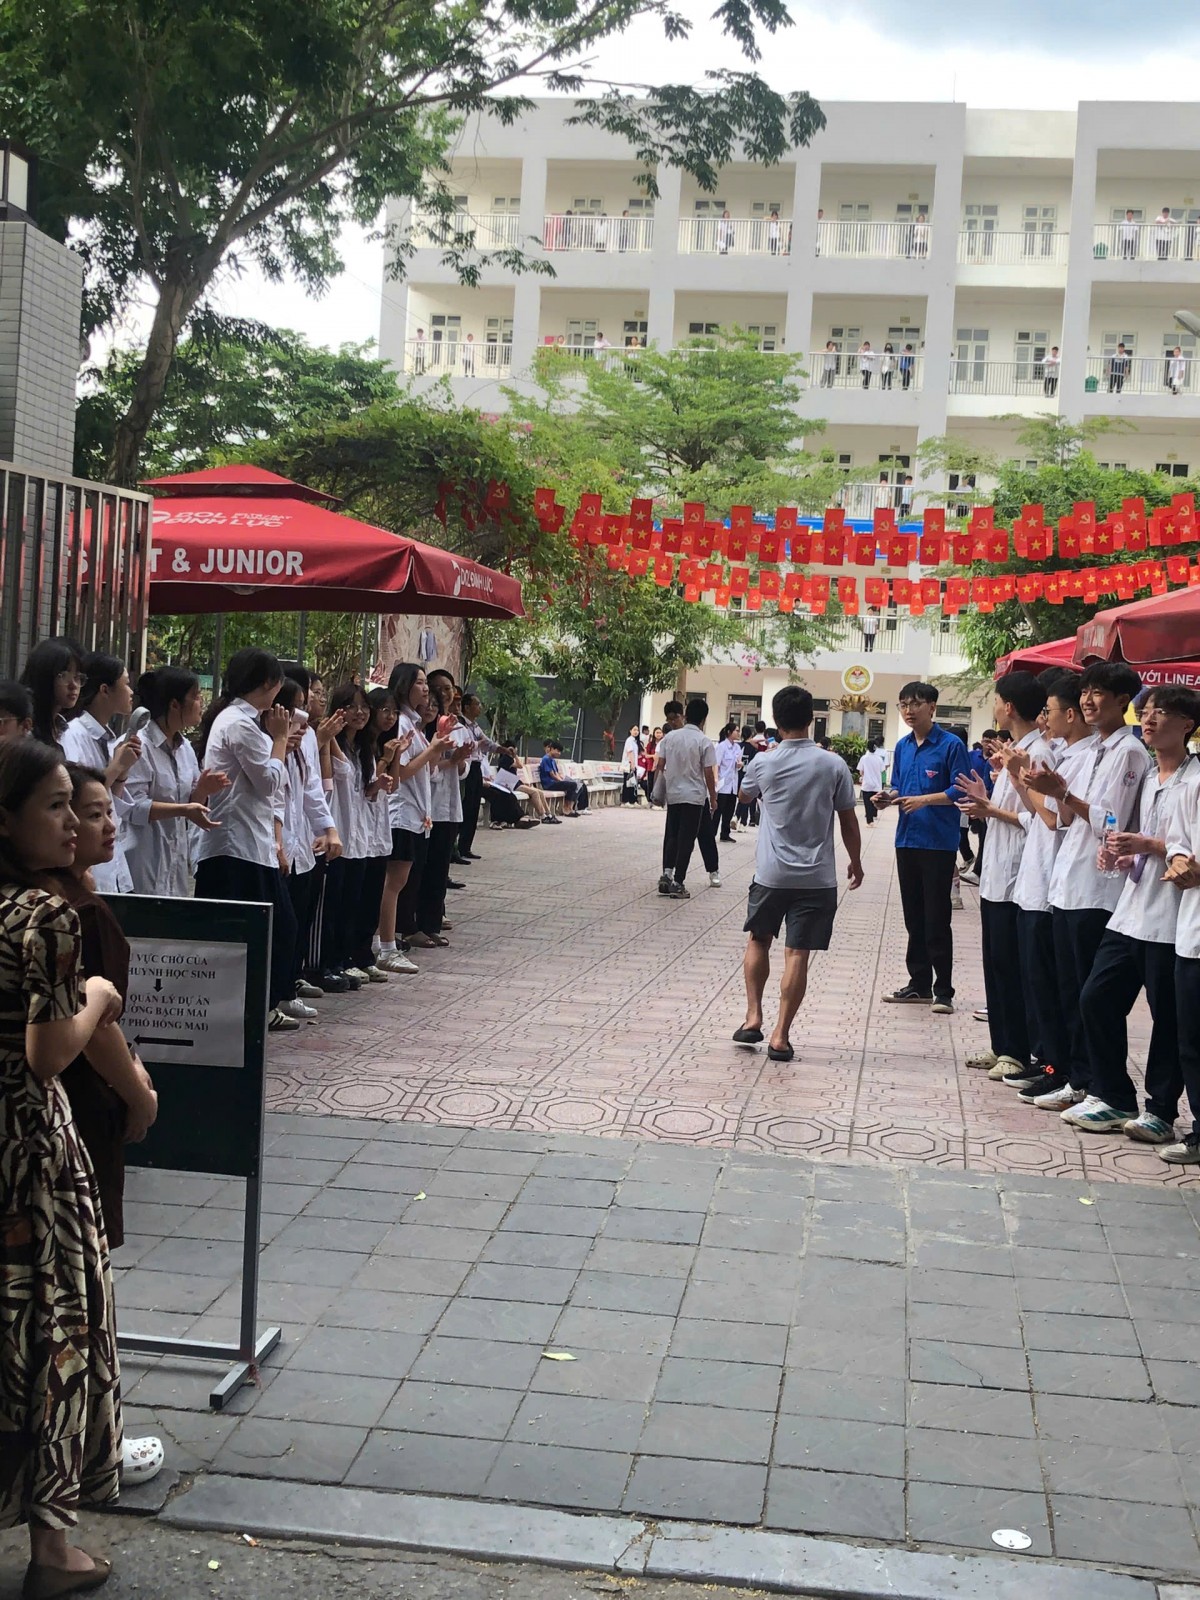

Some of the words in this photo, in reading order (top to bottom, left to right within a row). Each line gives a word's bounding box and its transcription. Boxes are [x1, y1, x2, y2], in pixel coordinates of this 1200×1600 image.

[172, 548, 191, 573] &
[199, 548, 304, 576] JUNIOR
[1138, 669, 1161, 683] VỚI
[137, 953, 159, 964] VỰC
[161, 953, 185, 964] CHỜ
[186, 954, 208, 966] CỦA
[165, 969, 189, 979] HỌC
[191, 970, 216, 979] SINH
[162, 994, 176, 1004] LÝ
[125, 1003, 153, 1014] ƯỜNG
[155, 1007, 184, 1018] BẠCH
[187, 1009, 207, 1018] MAI
[184, 1021, 209, 1032] MAI)
